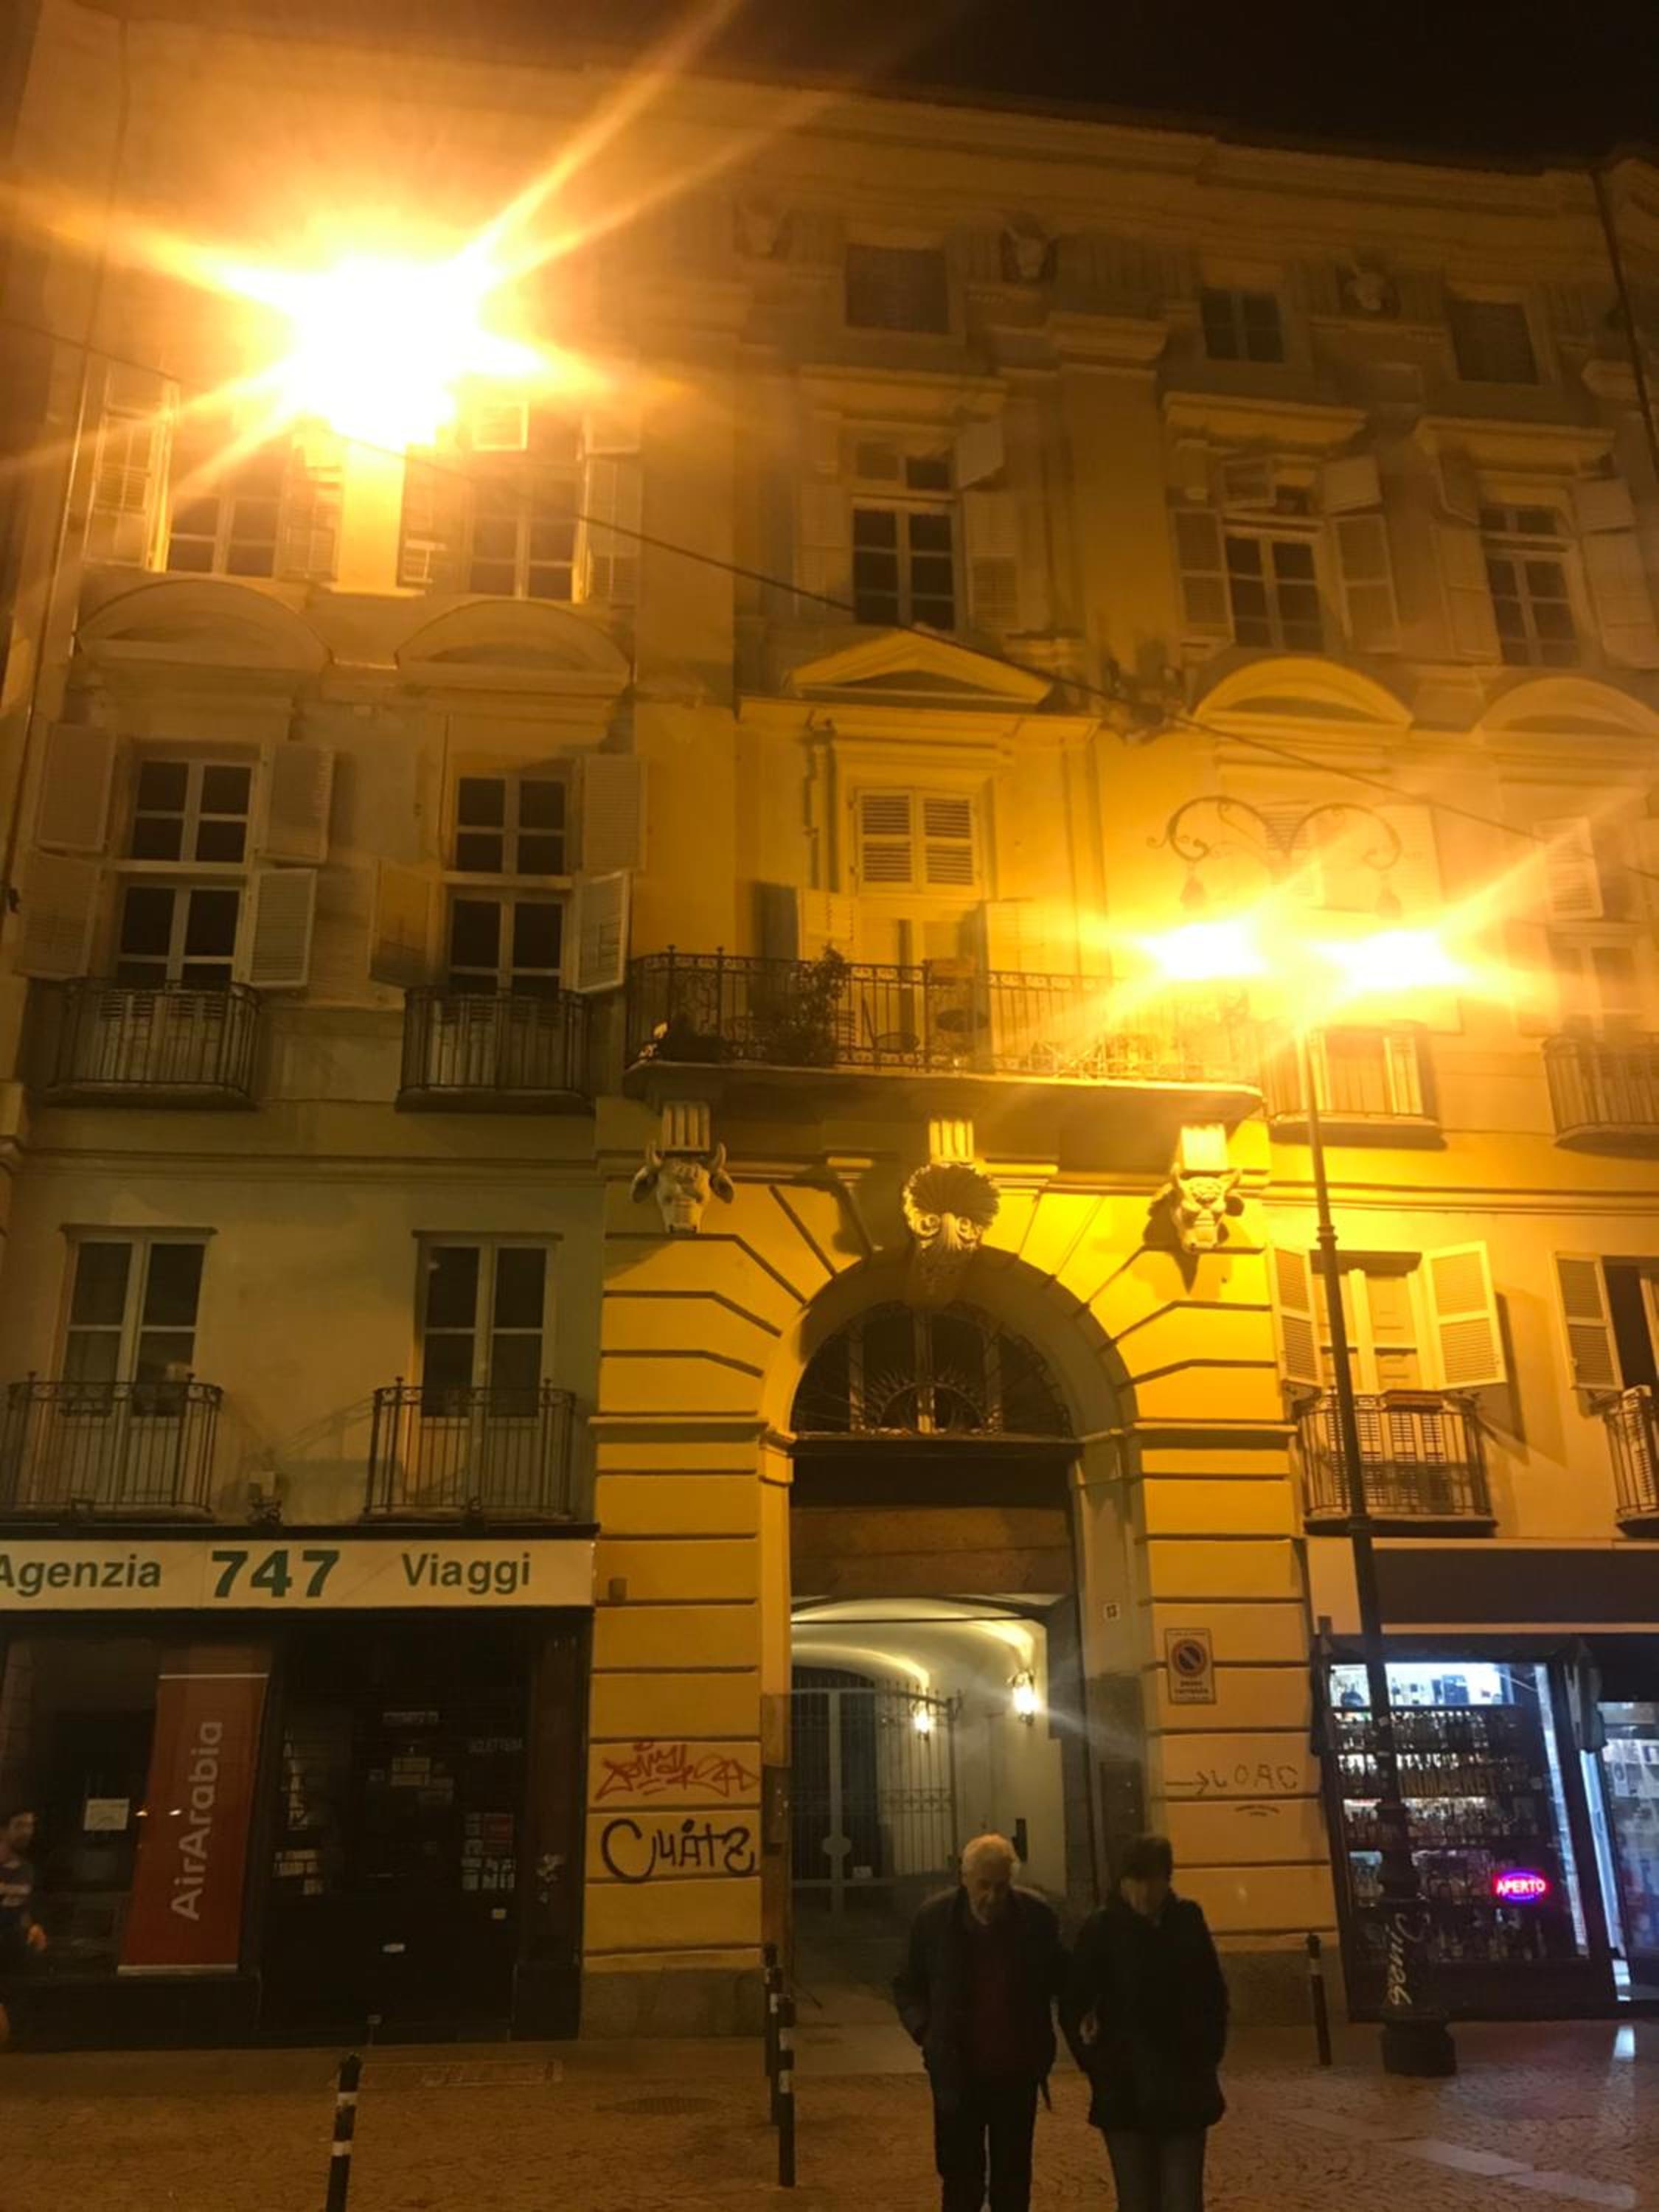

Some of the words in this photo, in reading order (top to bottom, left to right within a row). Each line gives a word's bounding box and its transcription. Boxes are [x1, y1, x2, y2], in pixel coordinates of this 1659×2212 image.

[0, 1553, 161, 1597] Agenzia
[211, 1549, 339, 1599] 747
[401, 1551, 531, 1596] Viaggi
[170, 1721, 223, 1921] AirArabia
[1496, 1878, 1546, 1896] APERTO
